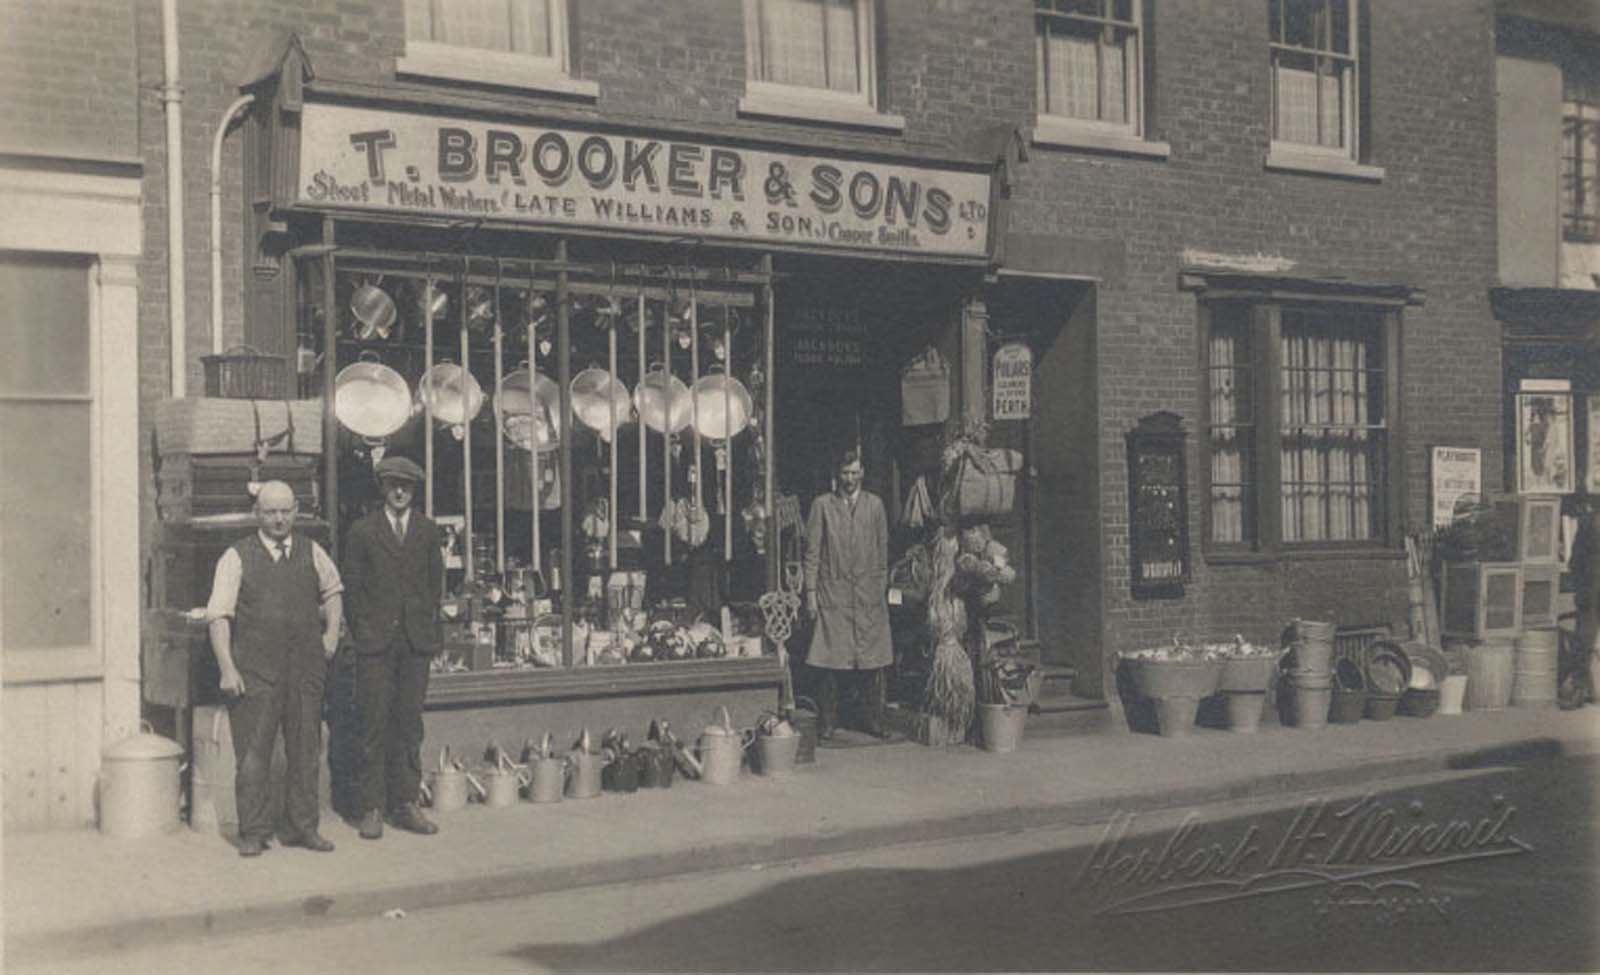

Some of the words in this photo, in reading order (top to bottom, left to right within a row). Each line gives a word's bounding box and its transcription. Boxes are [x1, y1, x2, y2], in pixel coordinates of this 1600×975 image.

[306, 168, 369, 203] Sheet
[388, 179, 434, 209] Metal
[591, 197, 713, 228] WILLIAMS
[729, 210, 748, 232] &
[829, 221, 874, 245] Copper
[349, 129, 420, 186] T.
[437, 126, 746, 202] BROOKER
[764, 160, 798, 207] &
[809, 163, 954, 236] SONS
[995, 399, 1027, 414] PERTH
